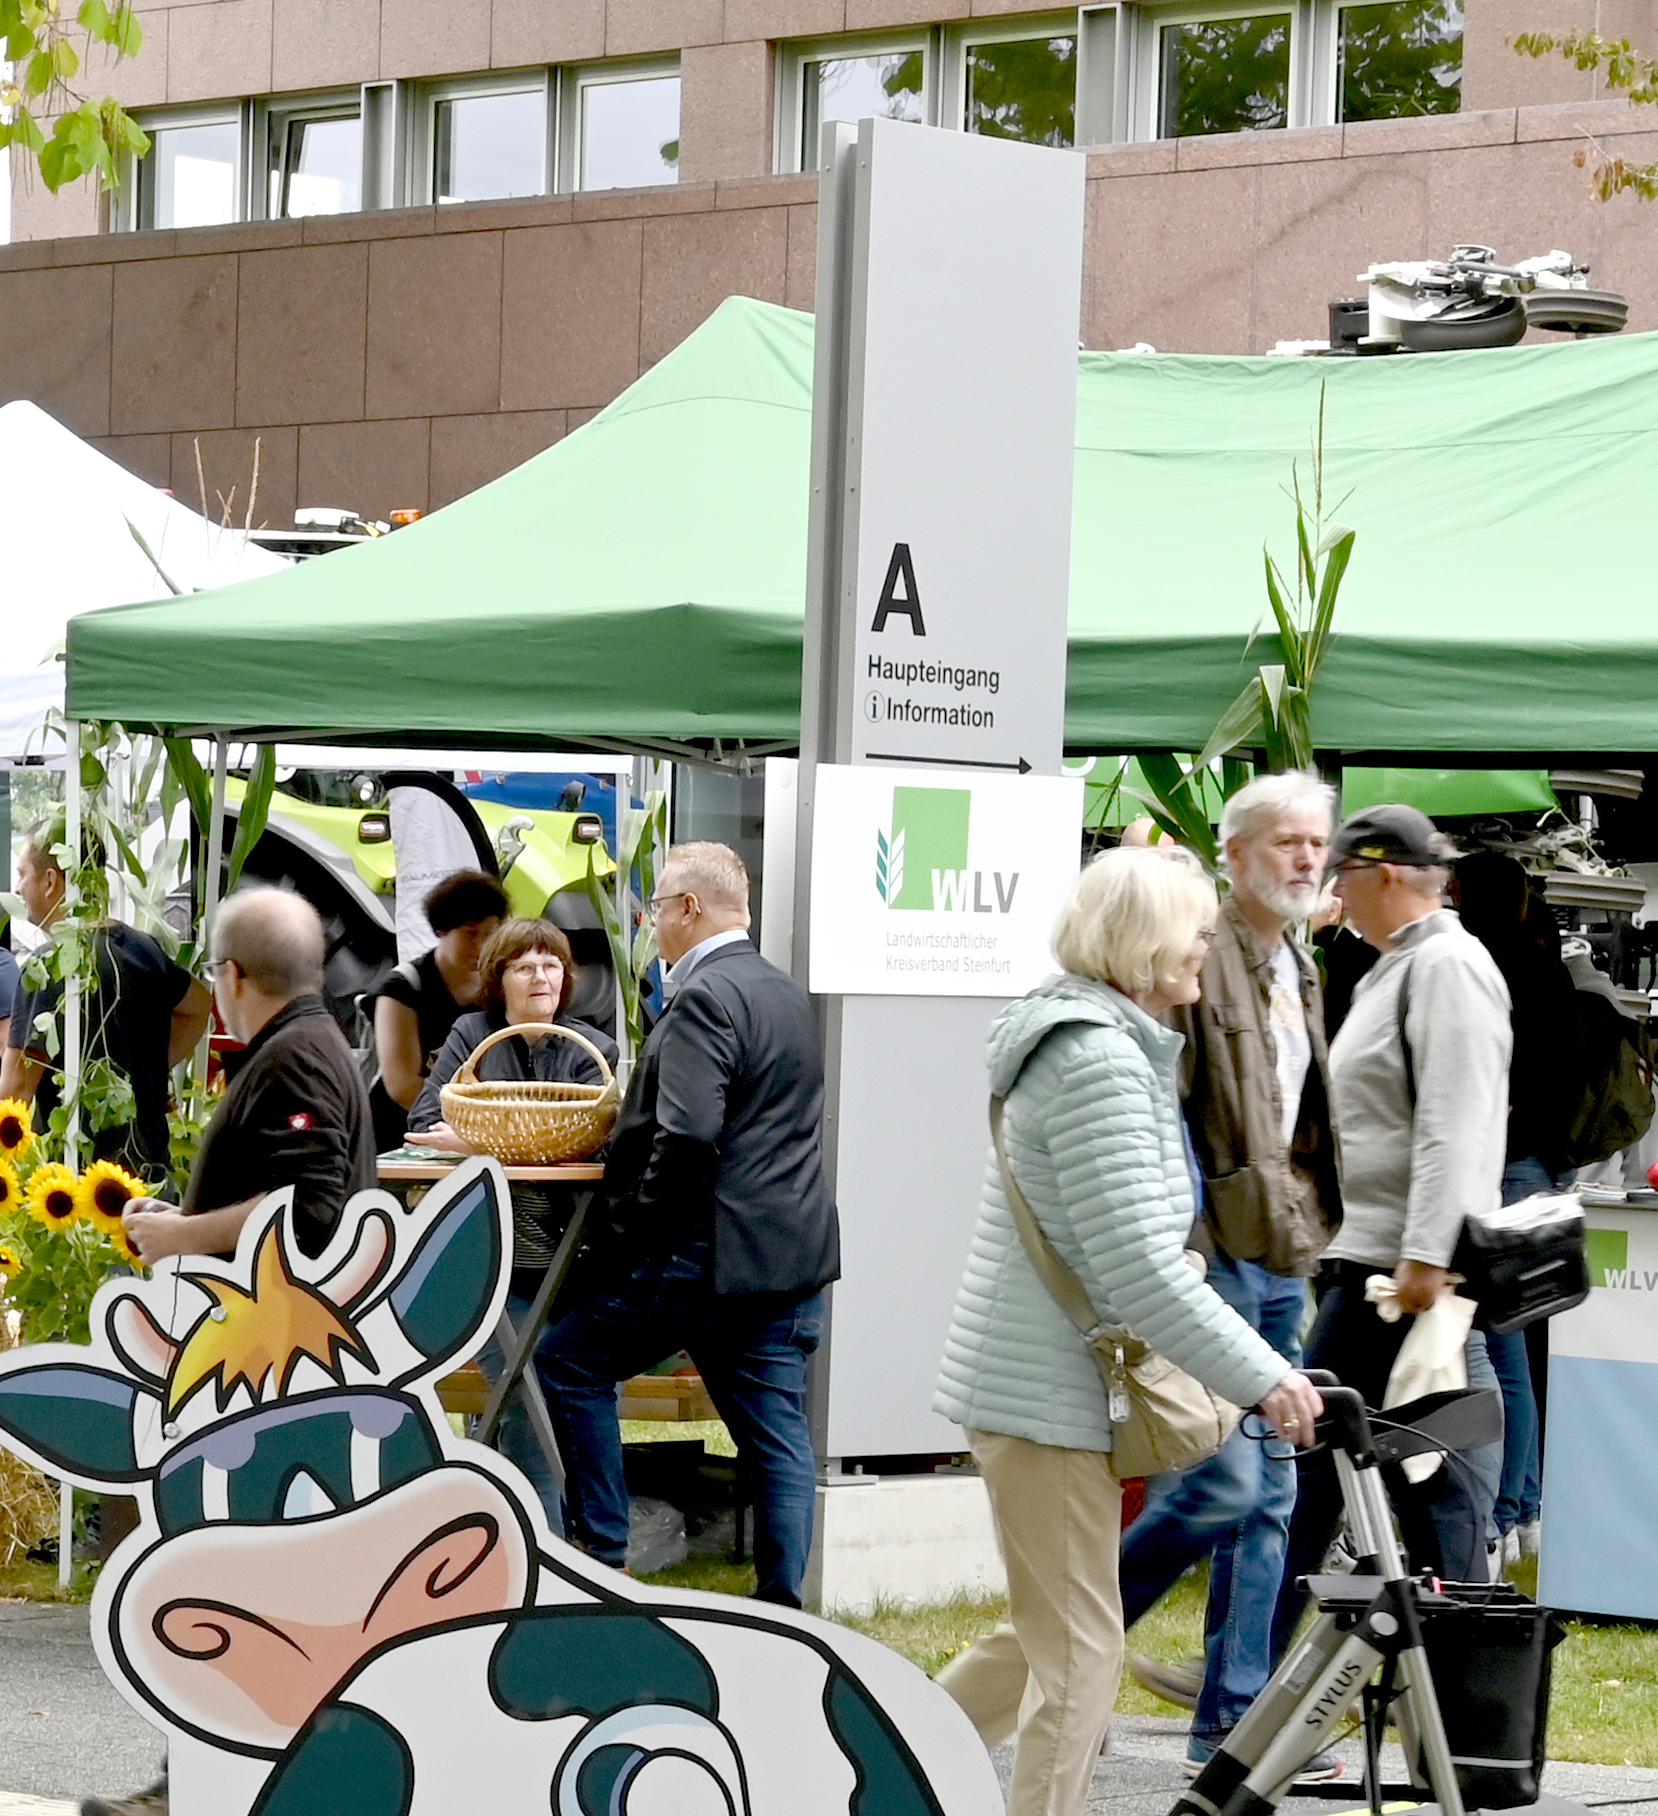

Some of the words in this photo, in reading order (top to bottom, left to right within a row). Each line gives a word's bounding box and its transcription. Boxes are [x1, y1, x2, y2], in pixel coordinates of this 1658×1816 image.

[871, 542, 926, 637] A
[868, 654, 1000, 694] Haupteingang
[887, 697, 994, 728] Information
[931, 868, 1020, 914] WLV
[886, 931, 998, 949] Landwirtschaftlicher
[886, 955, 959, 971] Kreisverband
[963, 956, 1011, 973] Steinfurt
[1604, 1267, 1658, 1292] WLV
[1305, 1659, 1362, 1730] STYLUS
